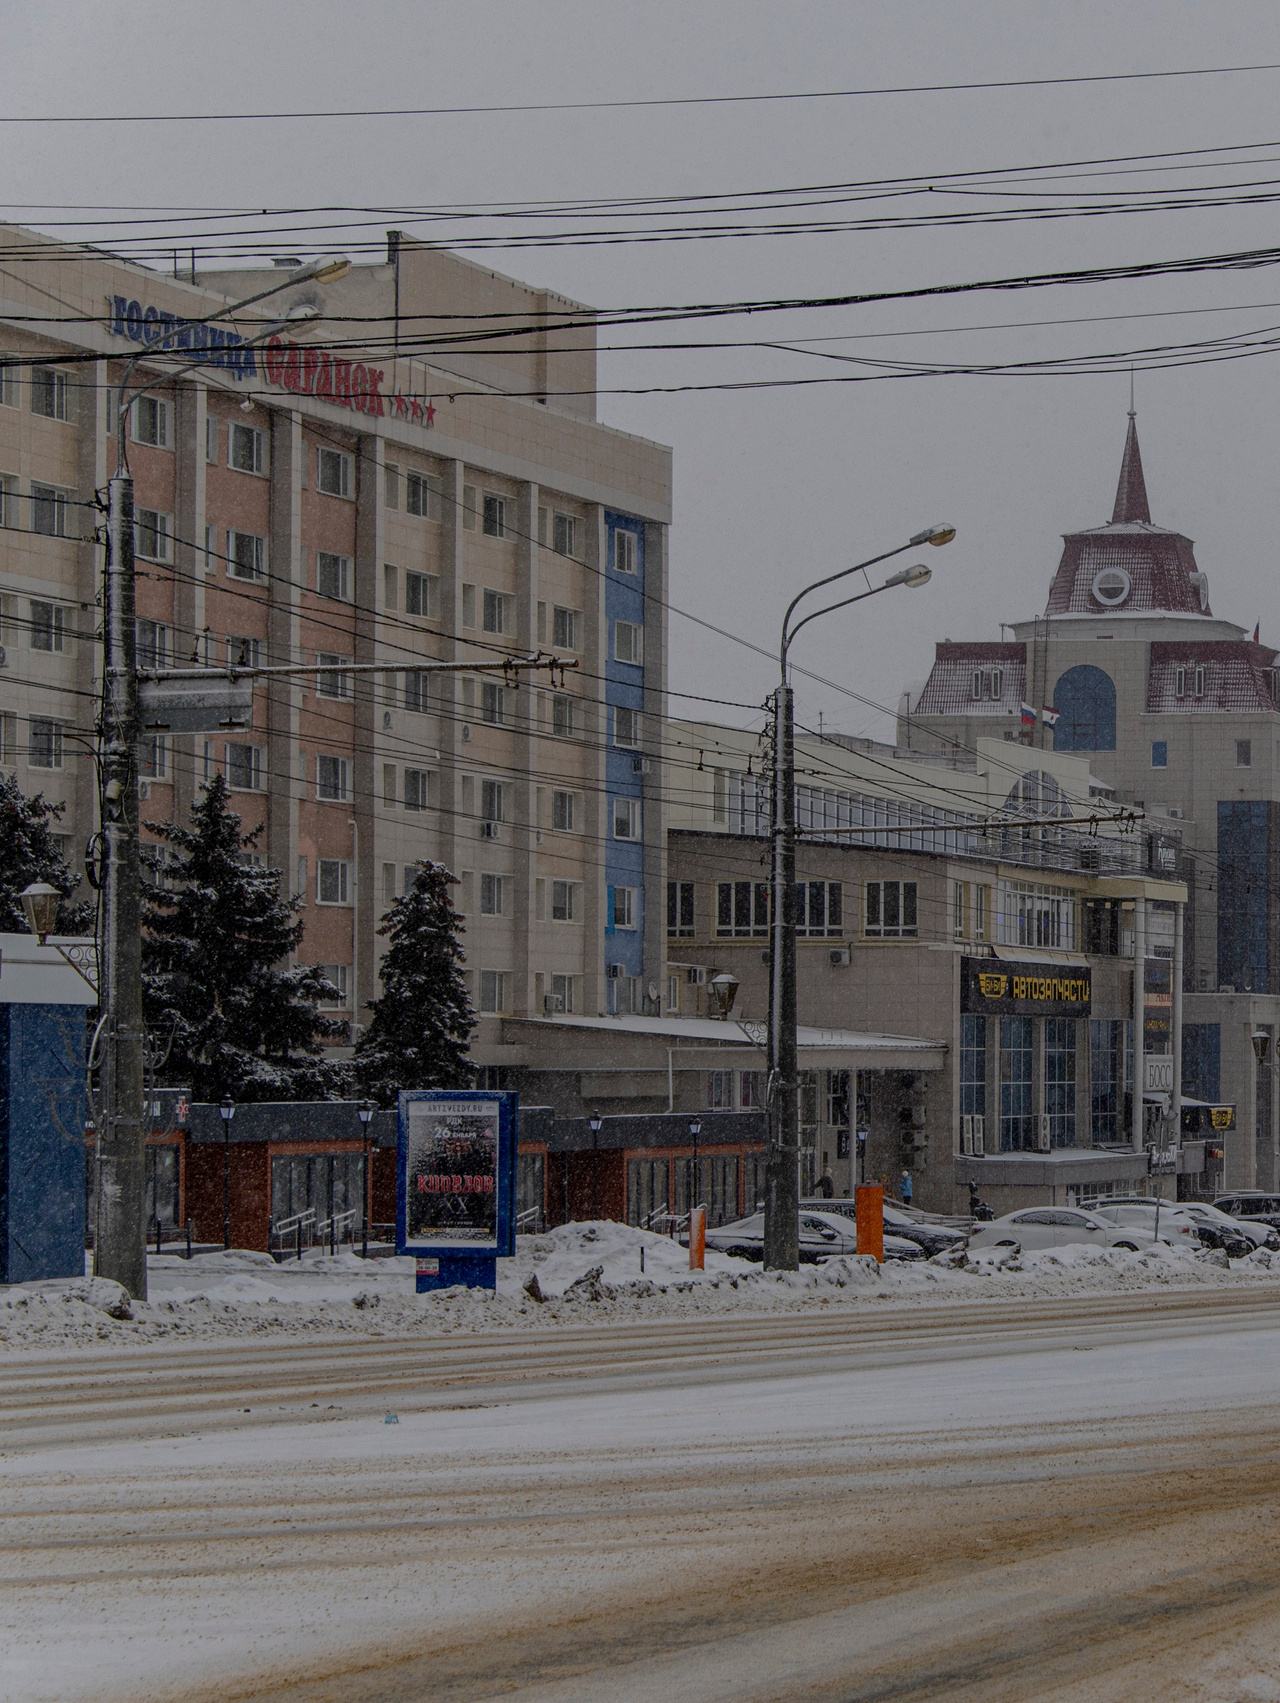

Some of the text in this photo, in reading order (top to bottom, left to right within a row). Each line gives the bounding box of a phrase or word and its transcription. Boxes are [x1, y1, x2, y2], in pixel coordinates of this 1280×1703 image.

[112, 294, 385, 417] ГОСТИНИЦА САРАНСК
[1013, 976, 1089, 1001] АВТОЗАПЧАСТИ
[1149, 1064, 1171, 1088] БОСС
[427, 1104, 483, 1113] ARTZVEZDY.RU
[434, 1126, 451, 1139] 26
